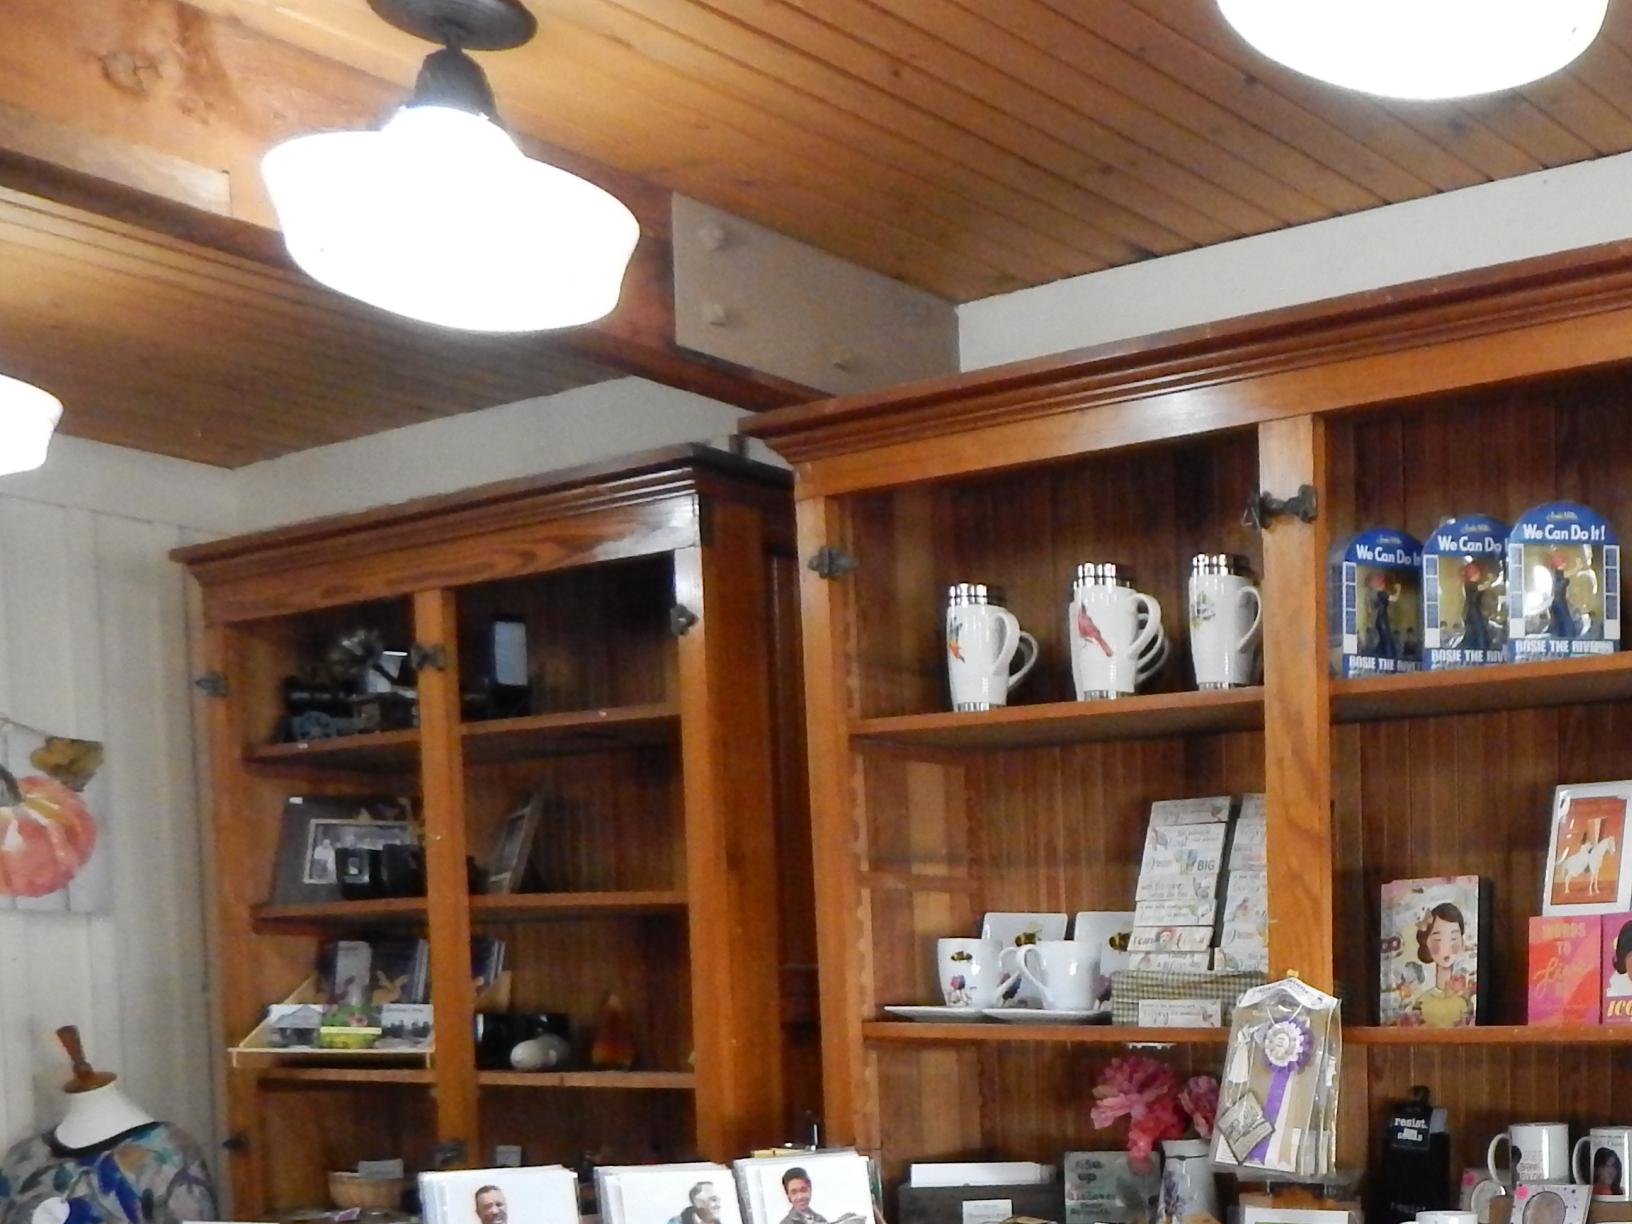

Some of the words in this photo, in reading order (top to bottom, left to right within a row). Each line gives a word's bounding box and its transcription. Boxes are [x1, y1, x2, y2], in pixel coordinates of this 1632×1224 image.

[1523, 524, 1544, 541] We
[1545, 524, 1569, 541] Can
[1570, 524, 1589, 540] Do
[1590, 524, 1606, 541] It!
[1438, 535, 1457, 551] We
[1459, 537, 1483, 551] Can
[1484, 537, 1502, 551] Do
[1356, 544, 1373, 560] We
[1374, 547, 1395, 563] Can
[1396, 549, 1411, 565] Do
[1515, 640, 1546, 655] ROSIE
[1550, 640, 1568, 653] THE
[1349, 655, 1377, 671] ROSIE
[1378, 658, 1395, 672] THE
[1431, 648, 1462, 664] ROSIE
[1465, 650, 1484, 663] THE
[1197, 859, 1216, 872] BIG
[1395, 1117, 1428, 1129] resist.
